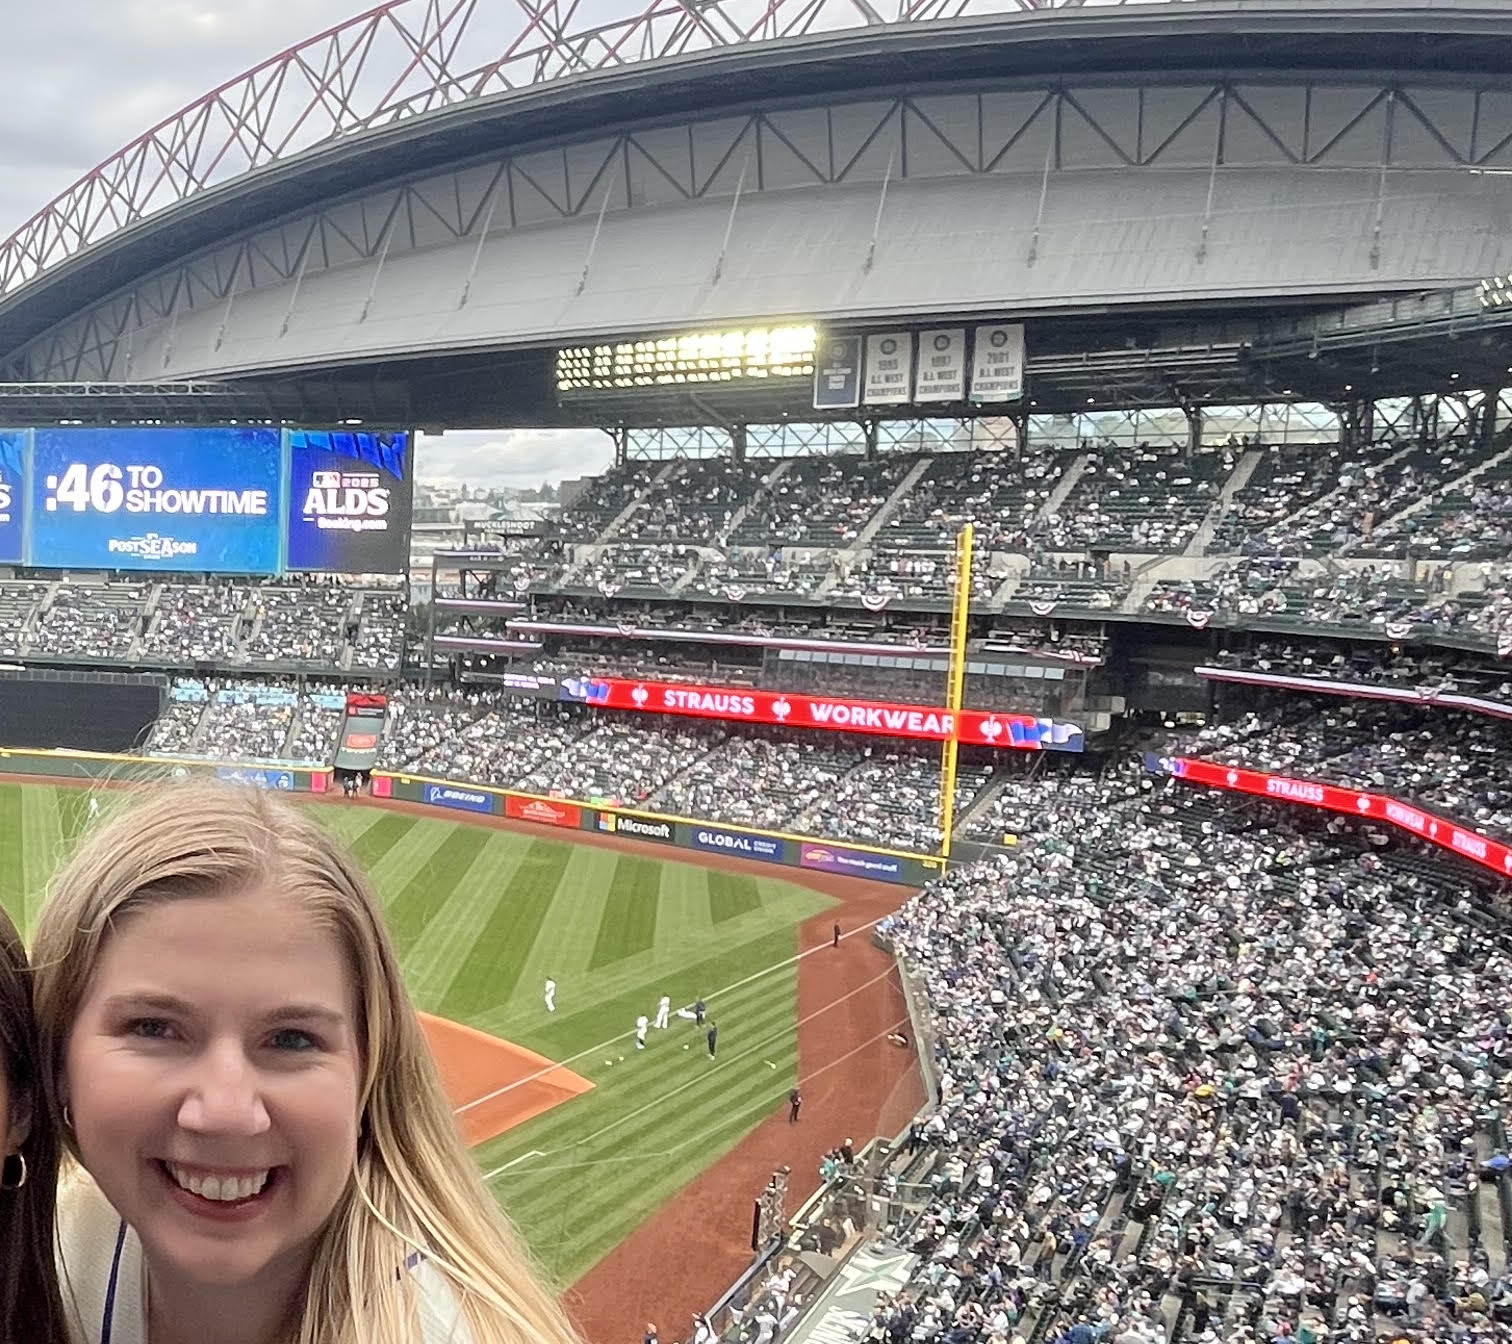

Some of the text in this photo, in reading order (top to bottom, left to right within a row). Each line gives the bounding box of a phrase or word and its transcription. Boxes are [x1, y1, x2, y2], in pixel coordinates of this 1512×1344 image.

[884, 373, 903, 384] WEST
[937, 370, 957, 380] WEST
[46, 464, 122, 513] :46
[130, 467, 163, 489] TO
[126, 490, 266, 515] SHOWTIME
[303, 488, 391, 515] ALDS
[664, 689, 955, 734] STRAUSS WORKWEAR
[618, 817, 670, 838] Microsoft
[1267, 779, 1323, 802] STRAUSS
[1452, 830, 1487, 858] STRAUSS
[698, 831, 751, 851] GLOBAL
